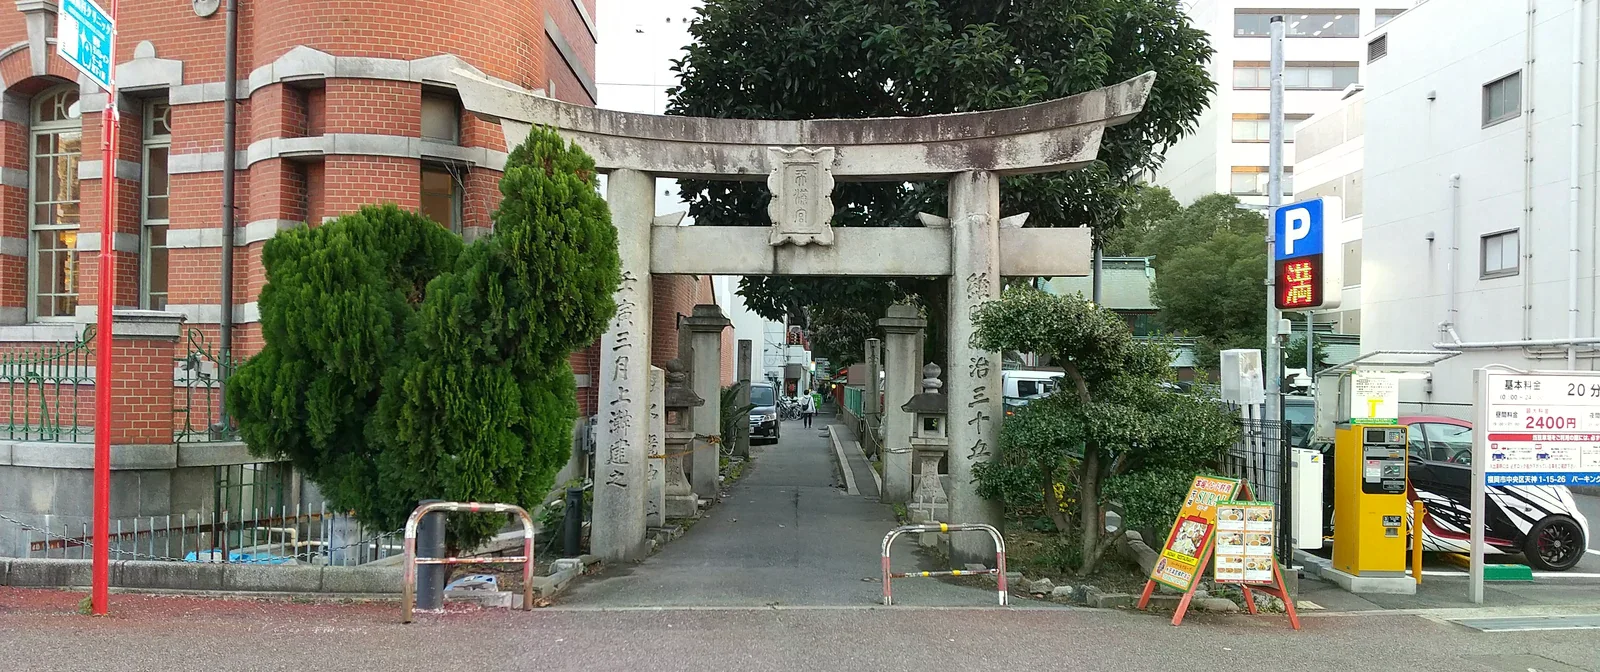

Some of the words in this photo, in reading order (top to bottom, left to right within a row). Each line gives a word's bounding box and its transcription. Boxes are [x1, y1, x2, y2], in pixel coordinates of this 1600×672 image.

[1285, 207, 1311, 255] P
[1286, 262, 1312, 304] 満
[1505, 379, 1541, 391] 基本料金
[1526, 416, 1576, 429] 2400円
